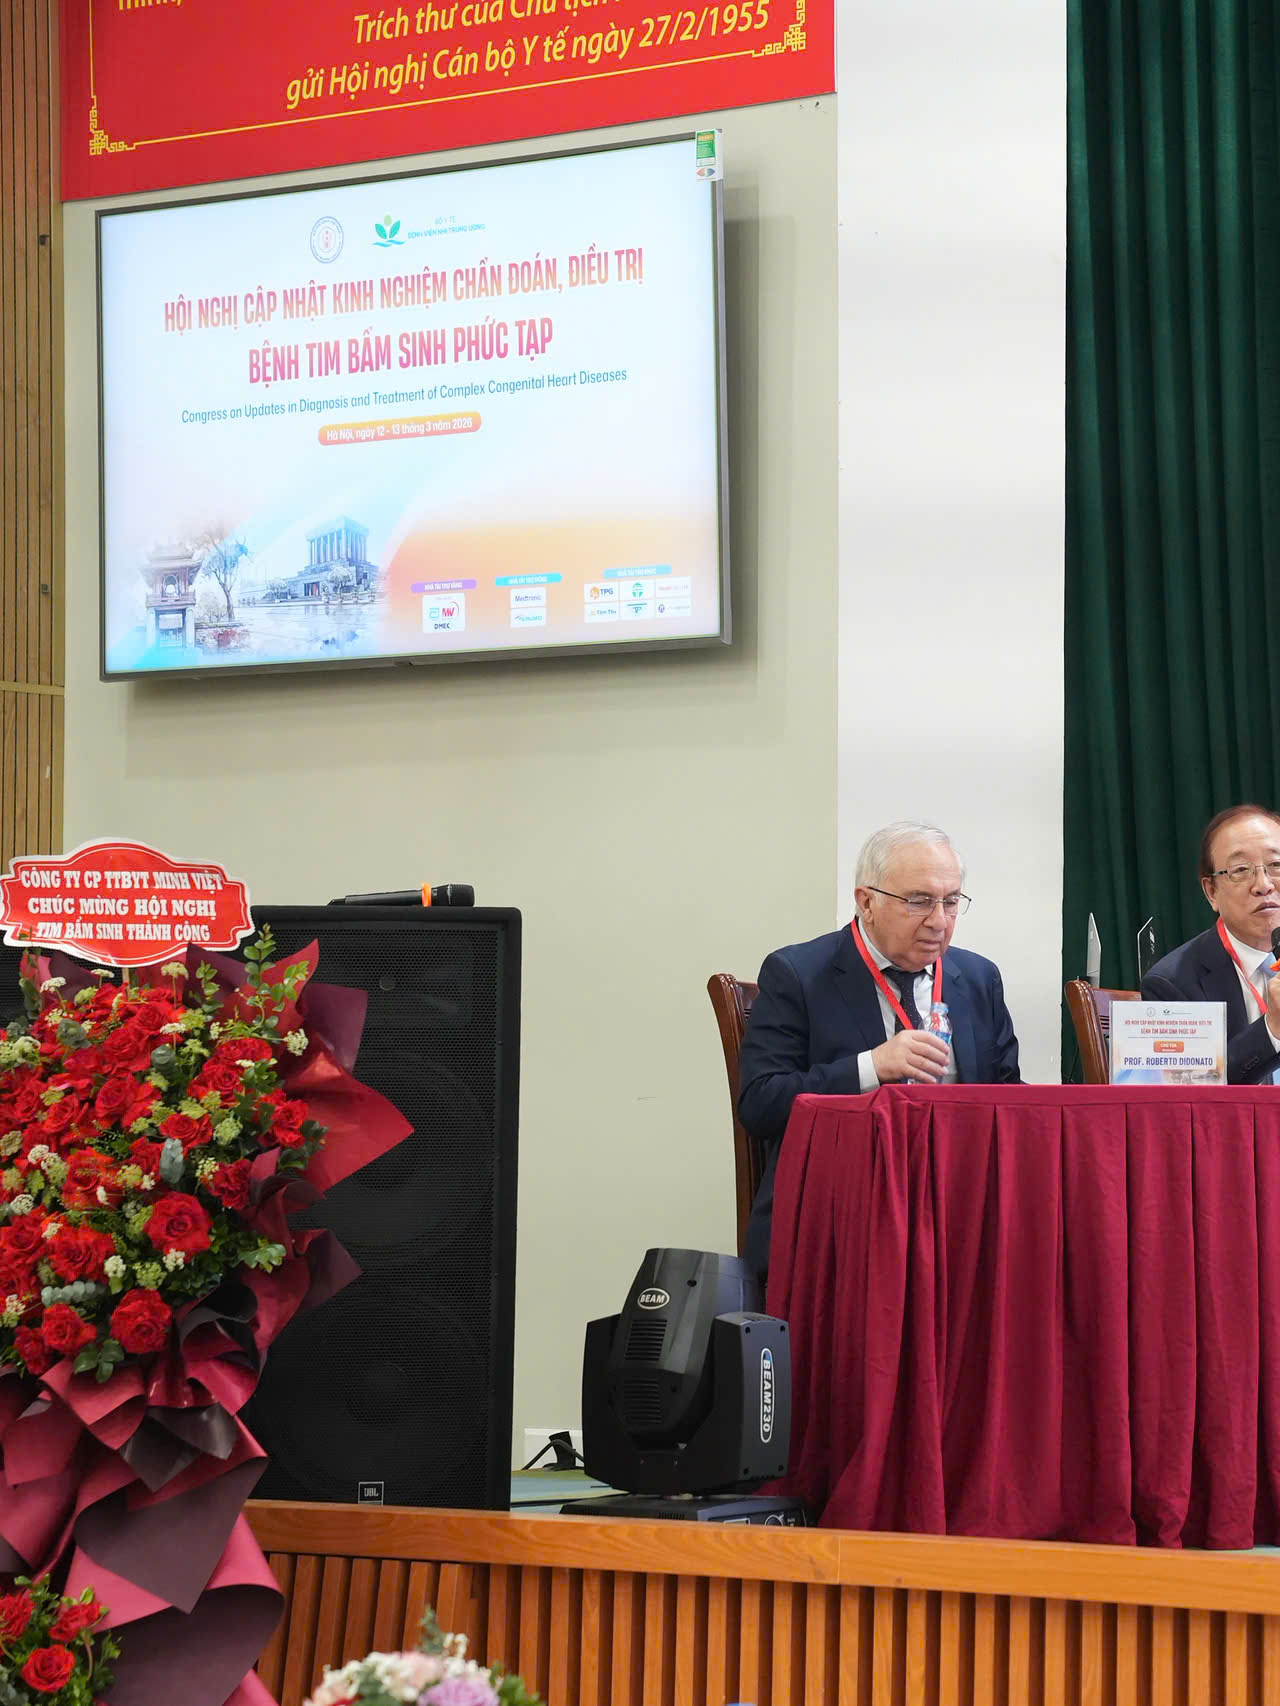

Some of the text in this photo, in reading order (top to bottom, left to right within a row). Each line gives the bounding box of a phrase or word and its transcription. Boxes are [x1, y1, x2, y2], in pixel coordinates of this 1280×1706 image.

[354, 8, 409, 44] Trích
[415, 3, 458, 34] thư
[461, 0, 503, 27] của
[287, 0, 770, 109] gửi Hội nghị Cán bộ Y tế ngày 27/2/1955
[165, 243, 643, 336] HỘI NGHỊ CẬP NHẬT KINH NGHIỆM CHẨN ĐOÁN, ĐIỀU TRỊ
[249, 339, 299, 388] BỆNH
[306, 340, 340, 377] TIM
[399, 329, 446, 369] SINH
[454, 315, 508, 363] PHỨC
[515, 318, 553, 361] TẠP
[182, 369, 627, 424] Congress on Updates in Diagnosis and Treatment of Complex Congenital Heart Diseases
[376, 425, 385, 437] 12
[392, 423, 400, 435] 13
[21, 867, 224, 894] CÔNG TY CP TTBYT MINH VIỆT
[28, 894, 216, 920] CHÚC MỪNG HỘI NGHỊ
[36, 922, 63, 938] TIM
[96, 923, 123, 940] SINH
[126, 920, 172, 941] THÀNH
[175, 920, 210, 941] CÔNG
[1124, 1057, 1213, 1066] PROF. ROBERTO DIDONATO
[640, 1294, 665, 1303] BEAM
[762, 1359, 772, 1433] BEAM230
[363, 1487, 379, 1497] JBL
